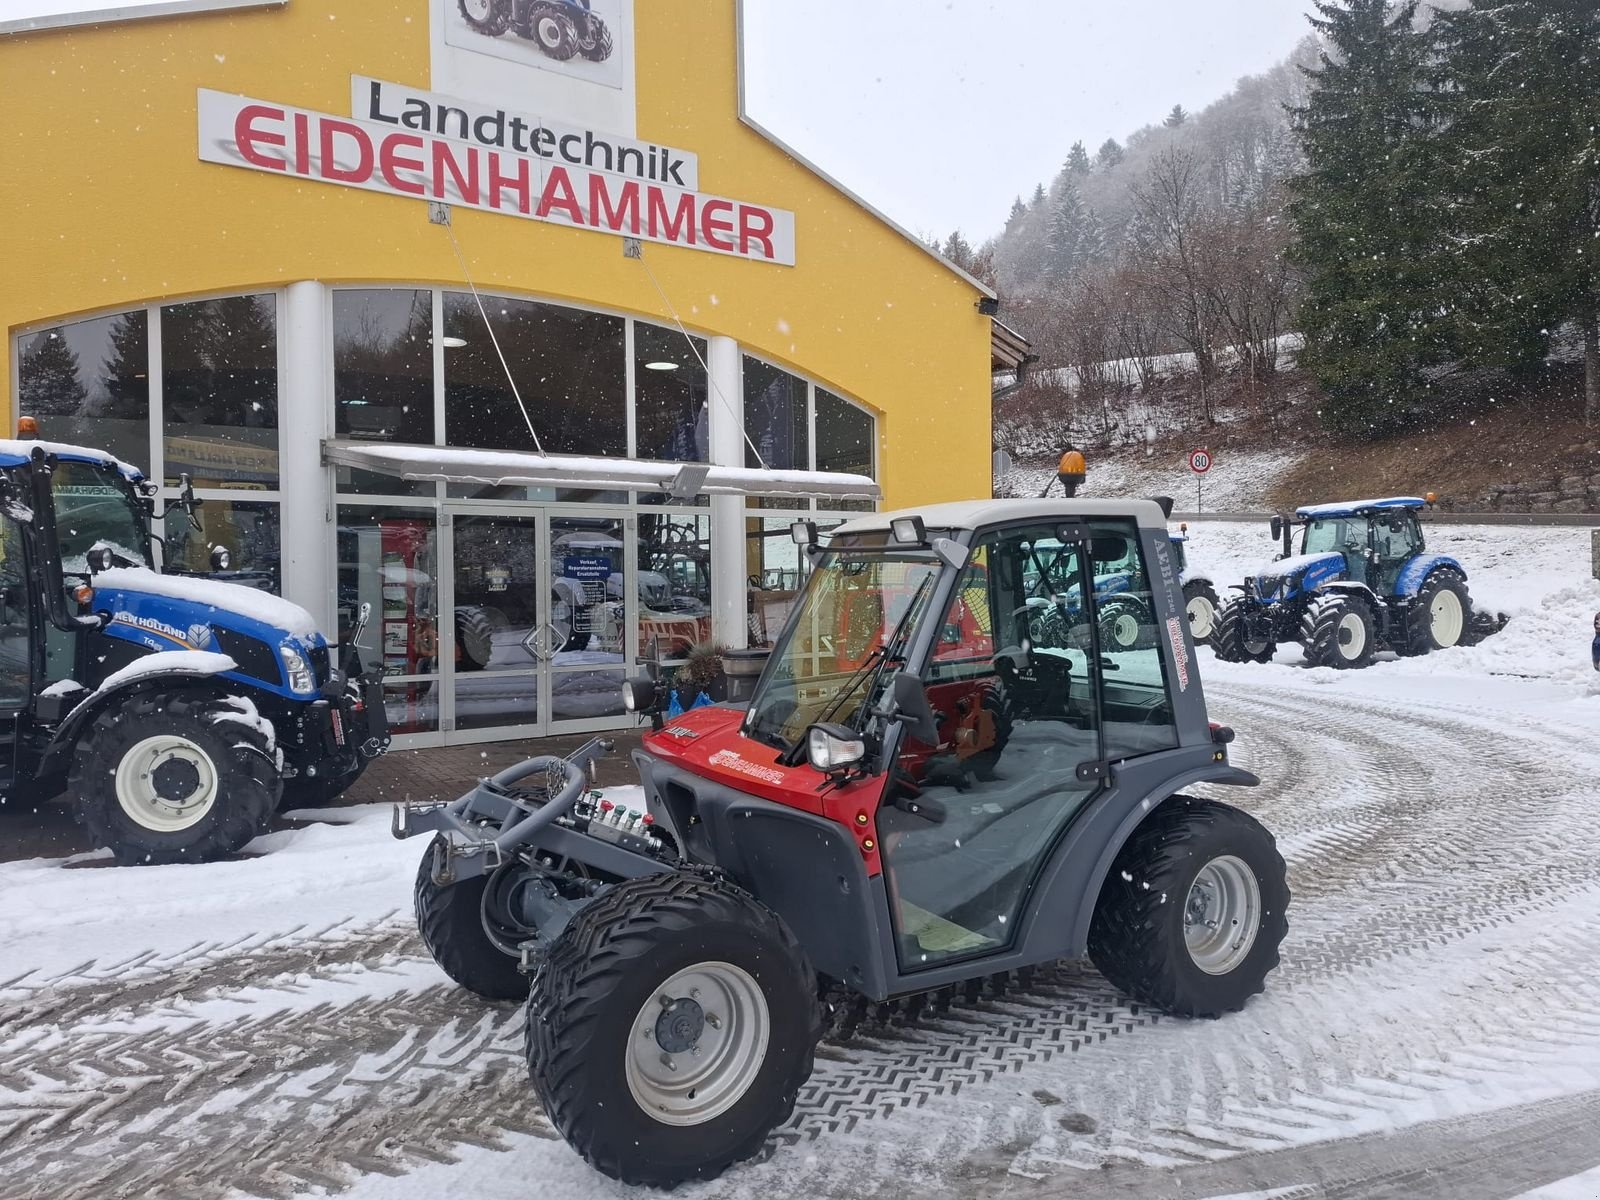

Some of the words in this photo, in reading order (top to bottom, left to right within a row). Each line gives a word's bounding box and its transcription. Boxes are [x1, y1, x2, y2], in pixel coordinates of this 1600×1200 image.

[369, 81, 687, 186] Landtechnik
[233, 105, 775, 259] EIDENHAMMER
[1194, 455, 1207, 467] 80
[1154, 538, 1175, 587] AEBI
[114, 612, 139, 625] NEW
[139, 617, 187, 640] HOLLAND
